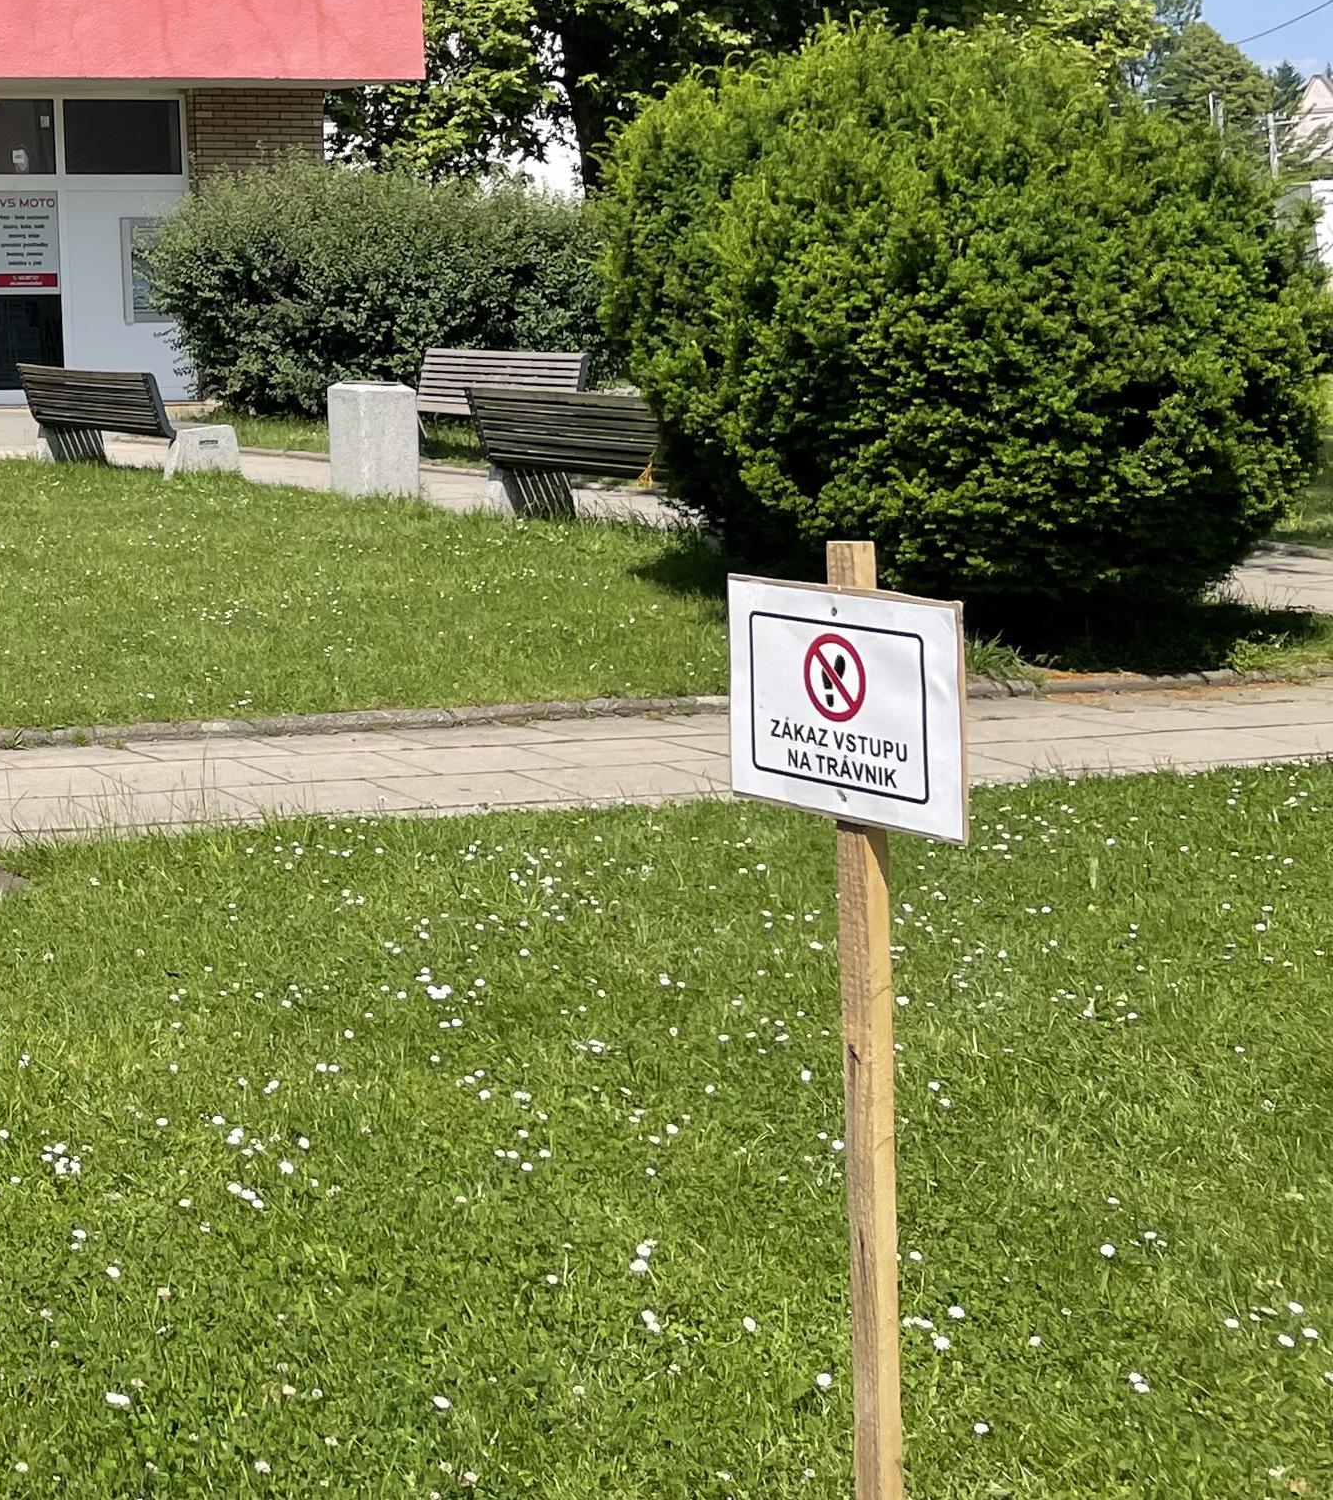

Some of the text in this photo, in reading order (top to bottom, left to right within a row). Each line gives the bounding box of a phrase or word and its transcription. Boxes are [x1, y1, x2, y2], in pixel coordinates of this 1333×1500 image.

[19, 198, 56, 208] MOTO
[770, 716, 909, 763] ZÁKAZ VSTUPU
[787, 749, 812, 772] NA
